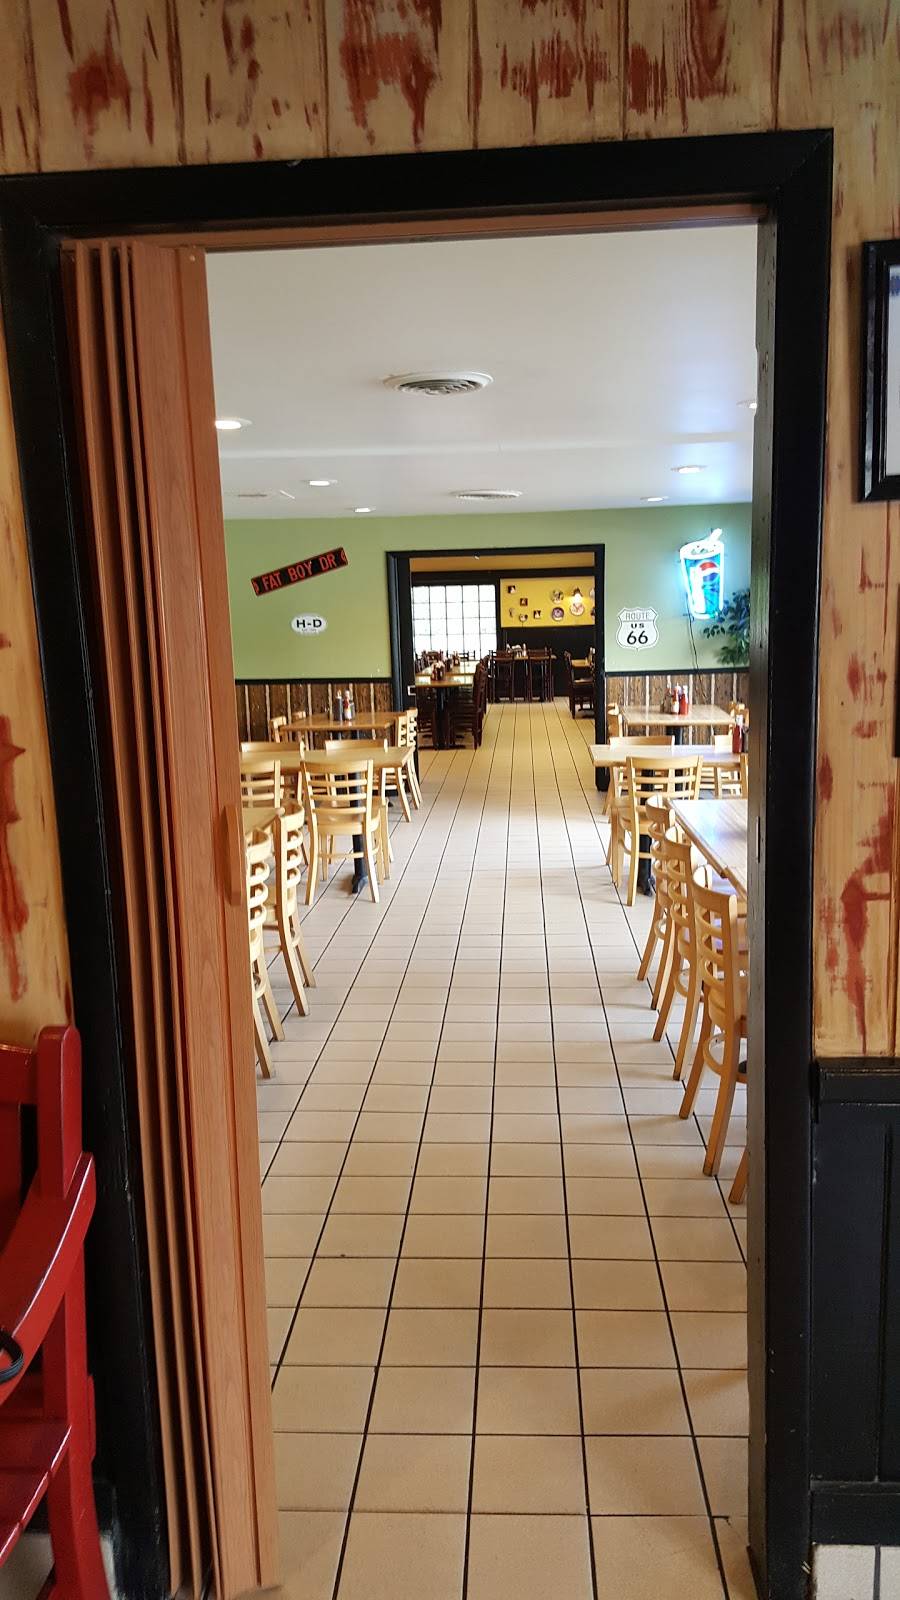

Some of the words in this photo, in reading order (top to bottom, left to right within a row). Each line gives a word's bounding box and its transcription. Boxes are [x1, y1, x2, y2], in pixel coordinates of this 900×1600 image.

[261, 572, 282, 591] FAT
[288, 561, 312, 582] BOY
[319, 553, 337, 571] DR
[296, 619, 322, 628] H-D
[627, 630, 648, 645] 66
